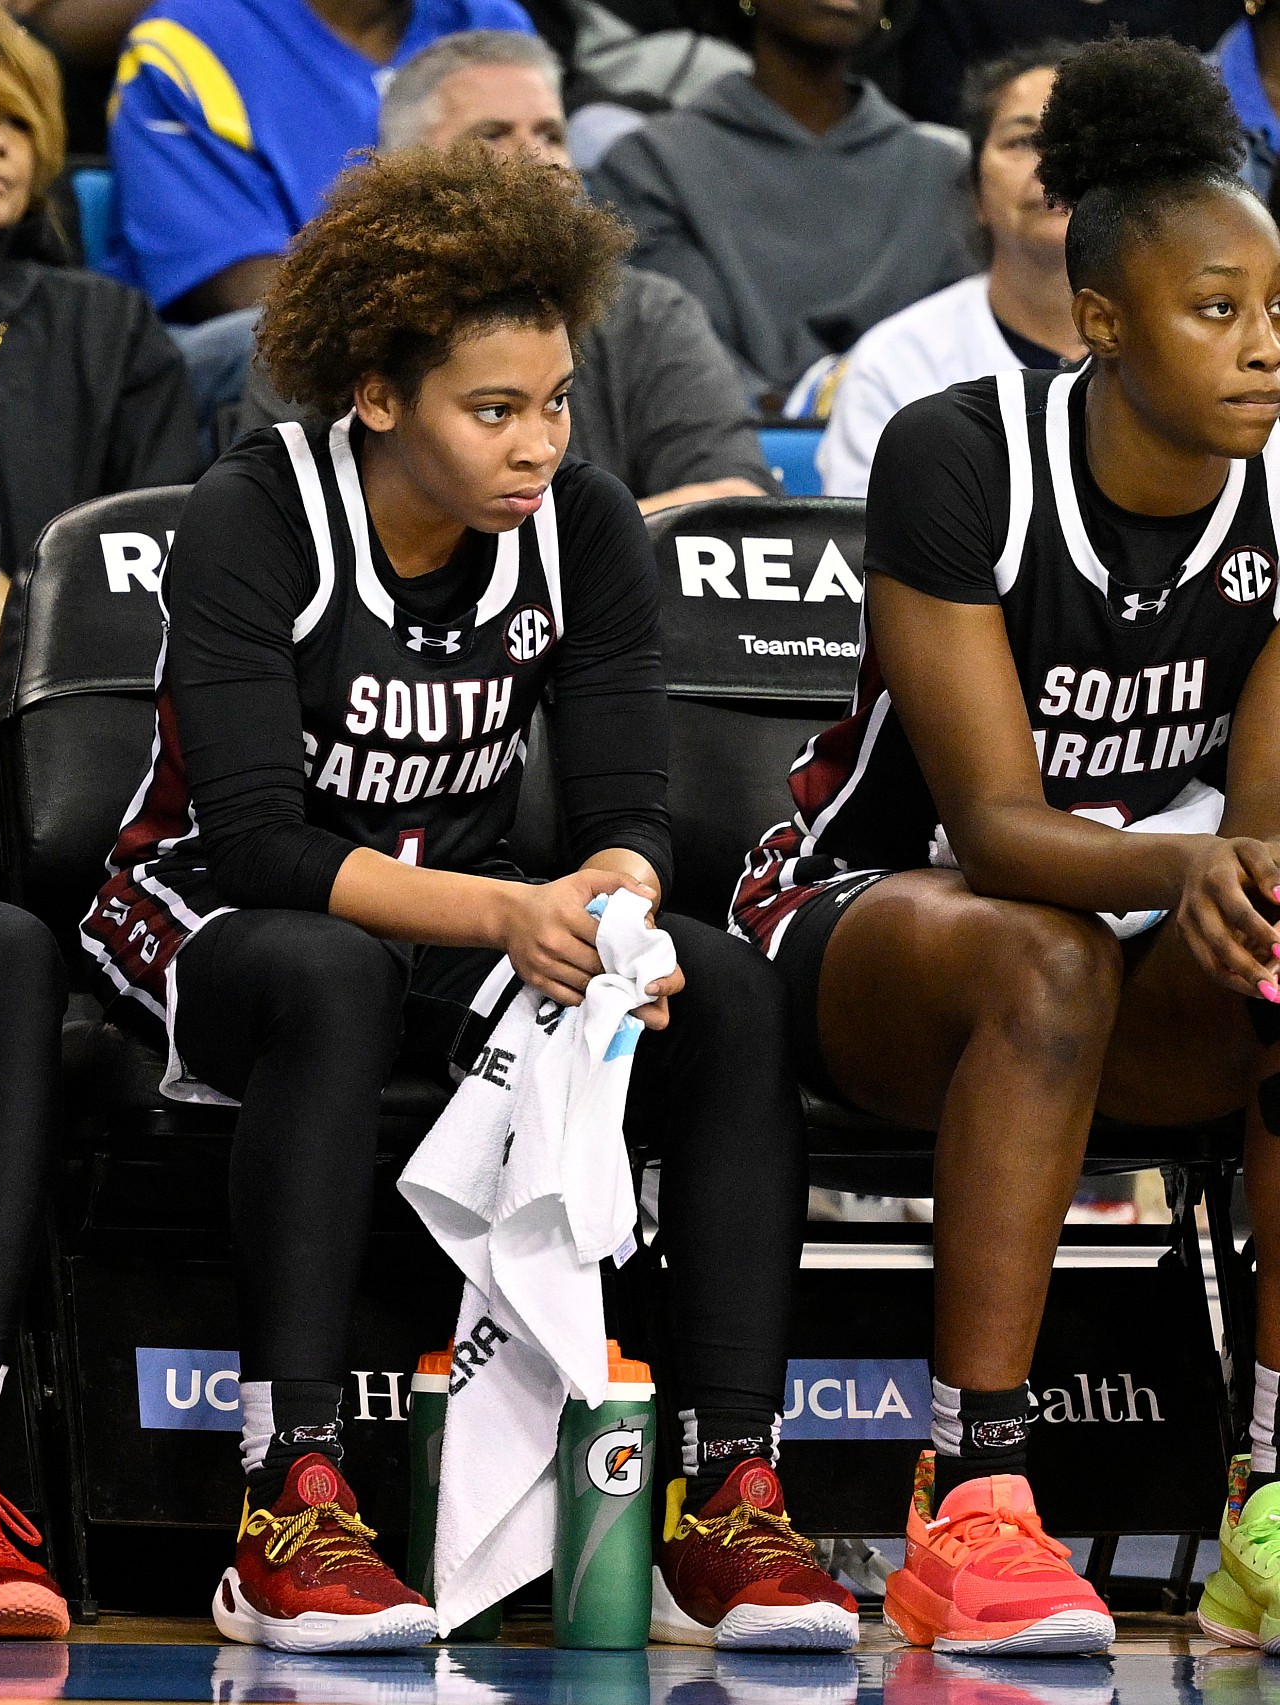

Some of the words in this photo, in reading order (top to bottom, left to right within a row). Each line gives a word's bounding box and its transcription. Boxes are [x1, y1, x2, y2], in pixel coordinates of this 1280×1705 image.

[675, 536, 864, 603] REA
[1221, 551, 1272, 603] SEC
[507, 608, 551, 661] SEC
[738, 634, 860, 657] TeamRea
[345, 674, 514, 743] SOUTH
[1038, 658, 1206, 724] SOUTH
